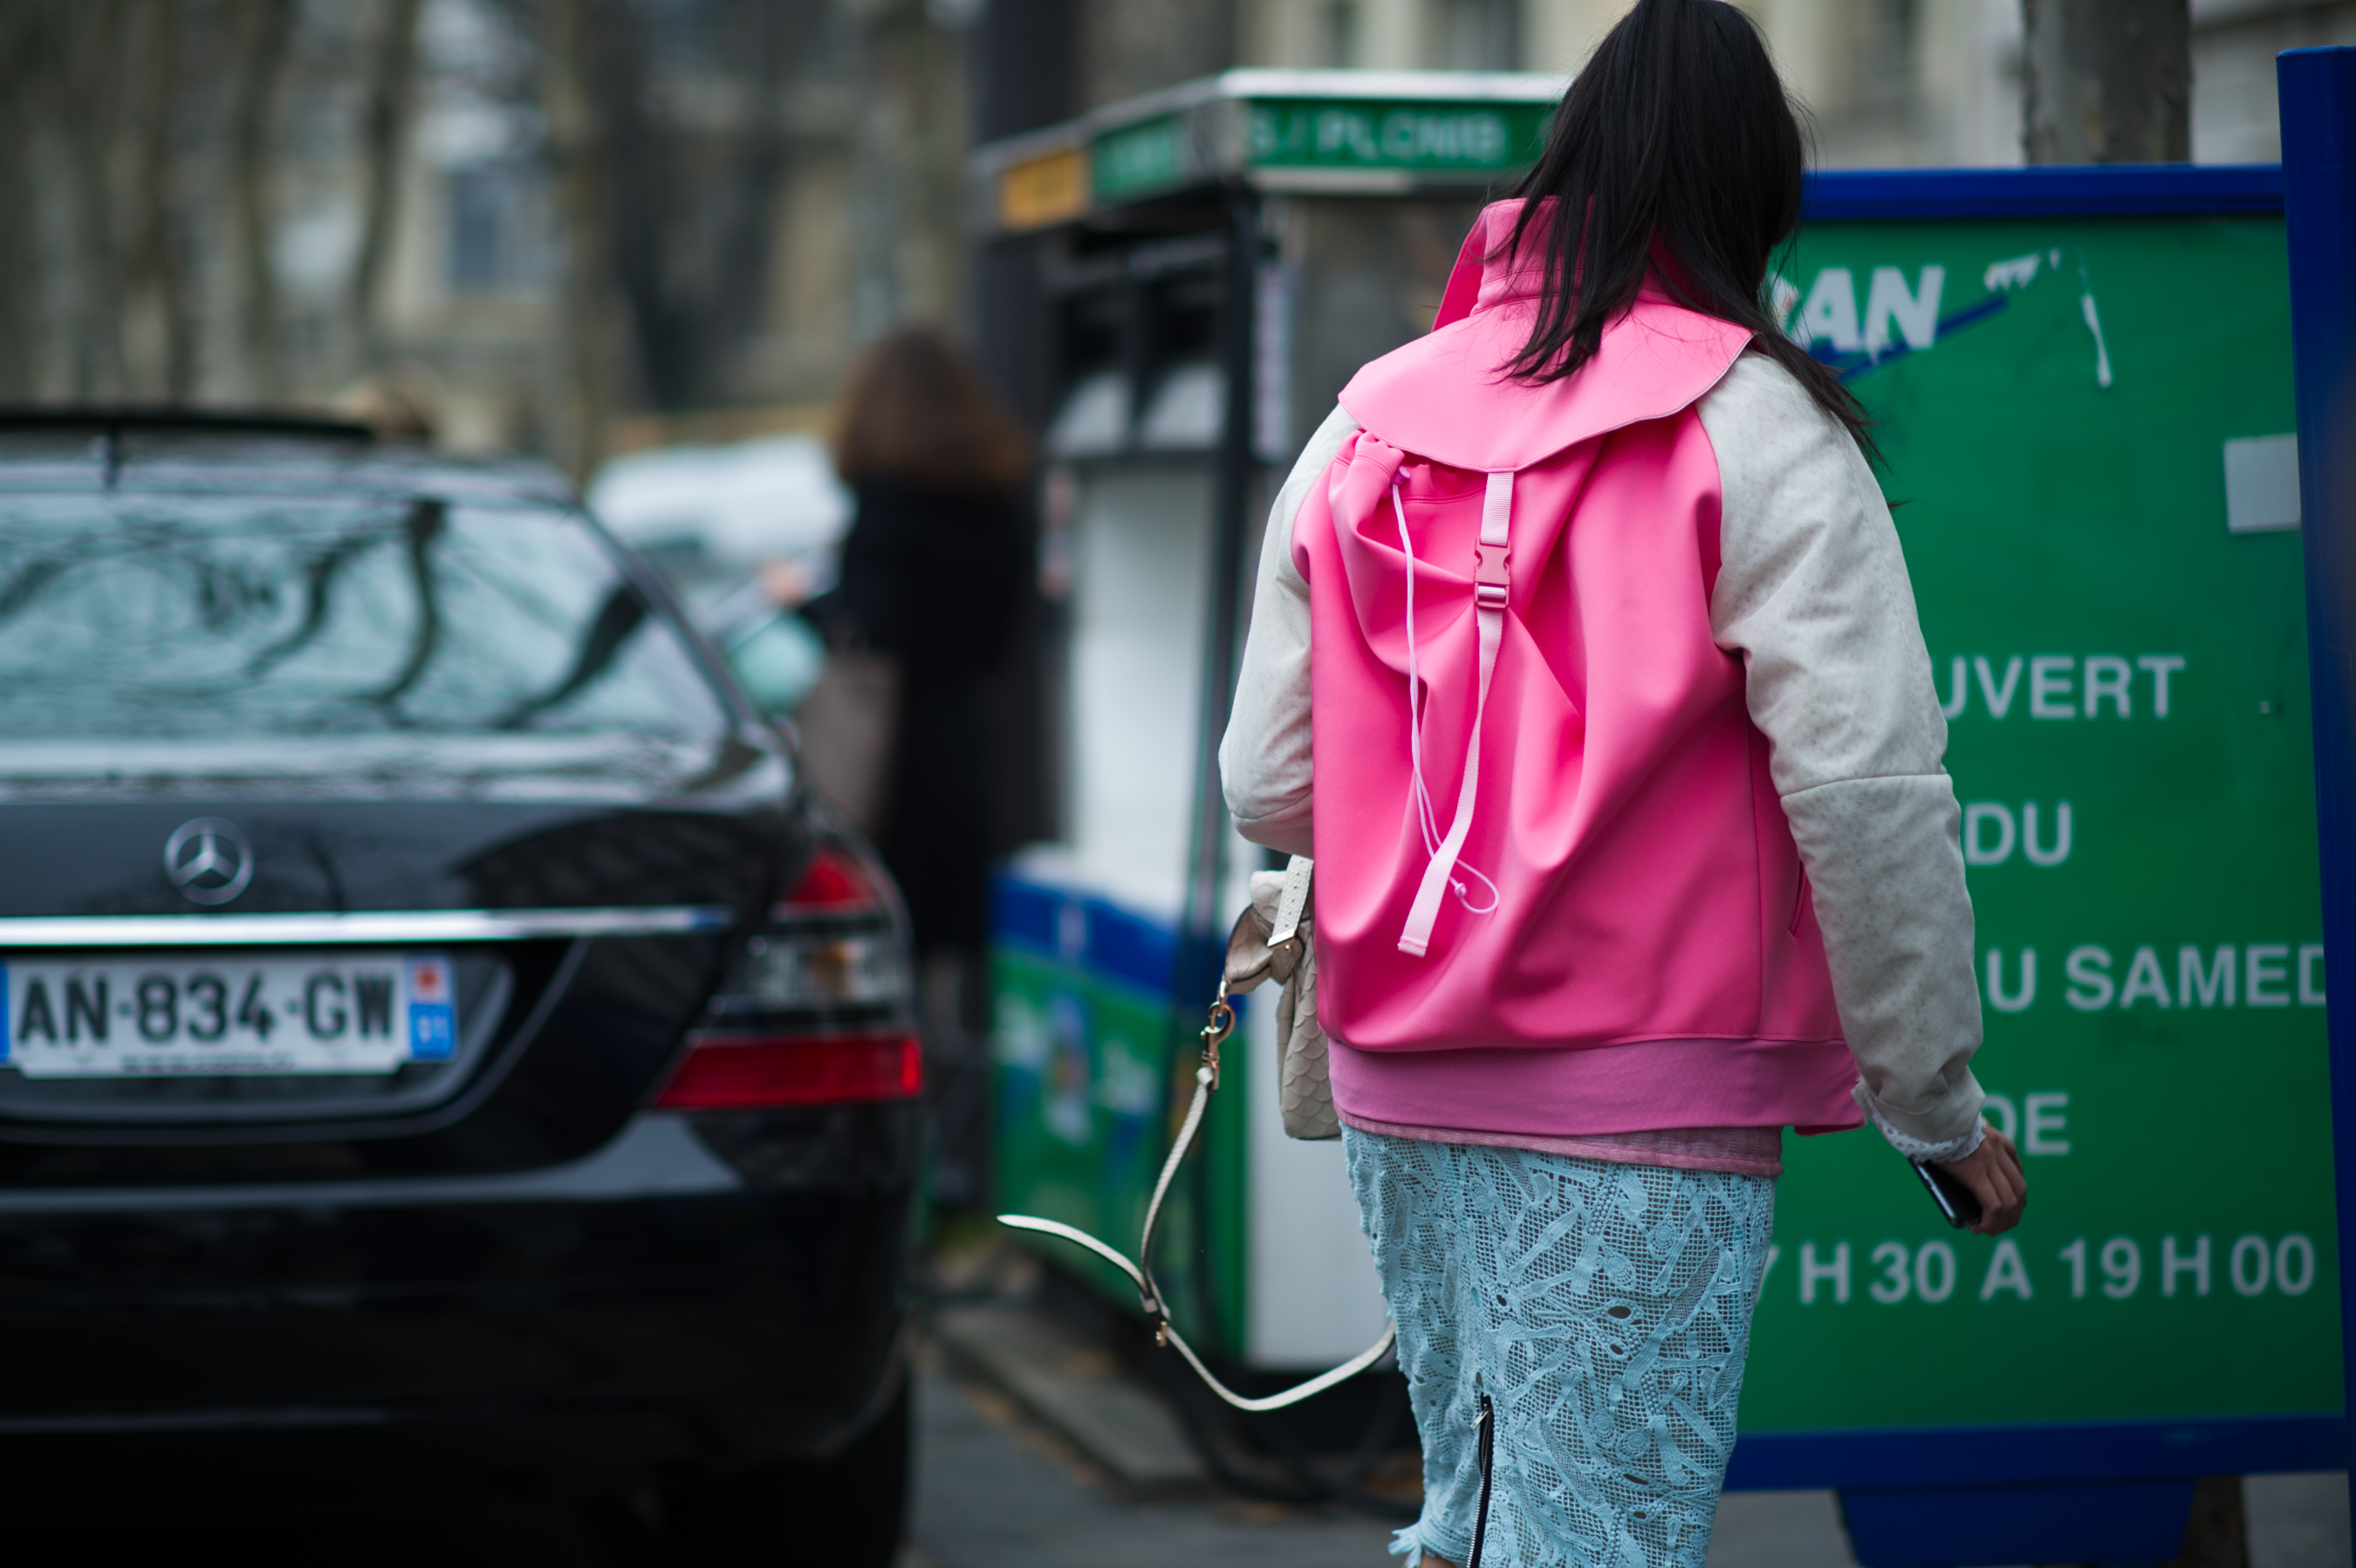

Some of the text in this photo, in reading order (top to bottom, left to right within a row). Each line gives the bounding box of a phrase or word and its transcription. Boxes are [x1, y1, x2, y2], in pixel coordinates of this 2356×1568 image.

[1963, 802, 2072, 866] DU
[16, 970, 396, 1045] AN-834-GW
[1799, 1242, 1851, 1304] H
[1869, 1241, 1956, 1304] 30
[1979, 1238, 2033, 1300] A
[2058, 1236, 2141, 1298] 19
[2161, 1234, 2211, 1297] H
[2229, 1234, 2316, 1296] 00
